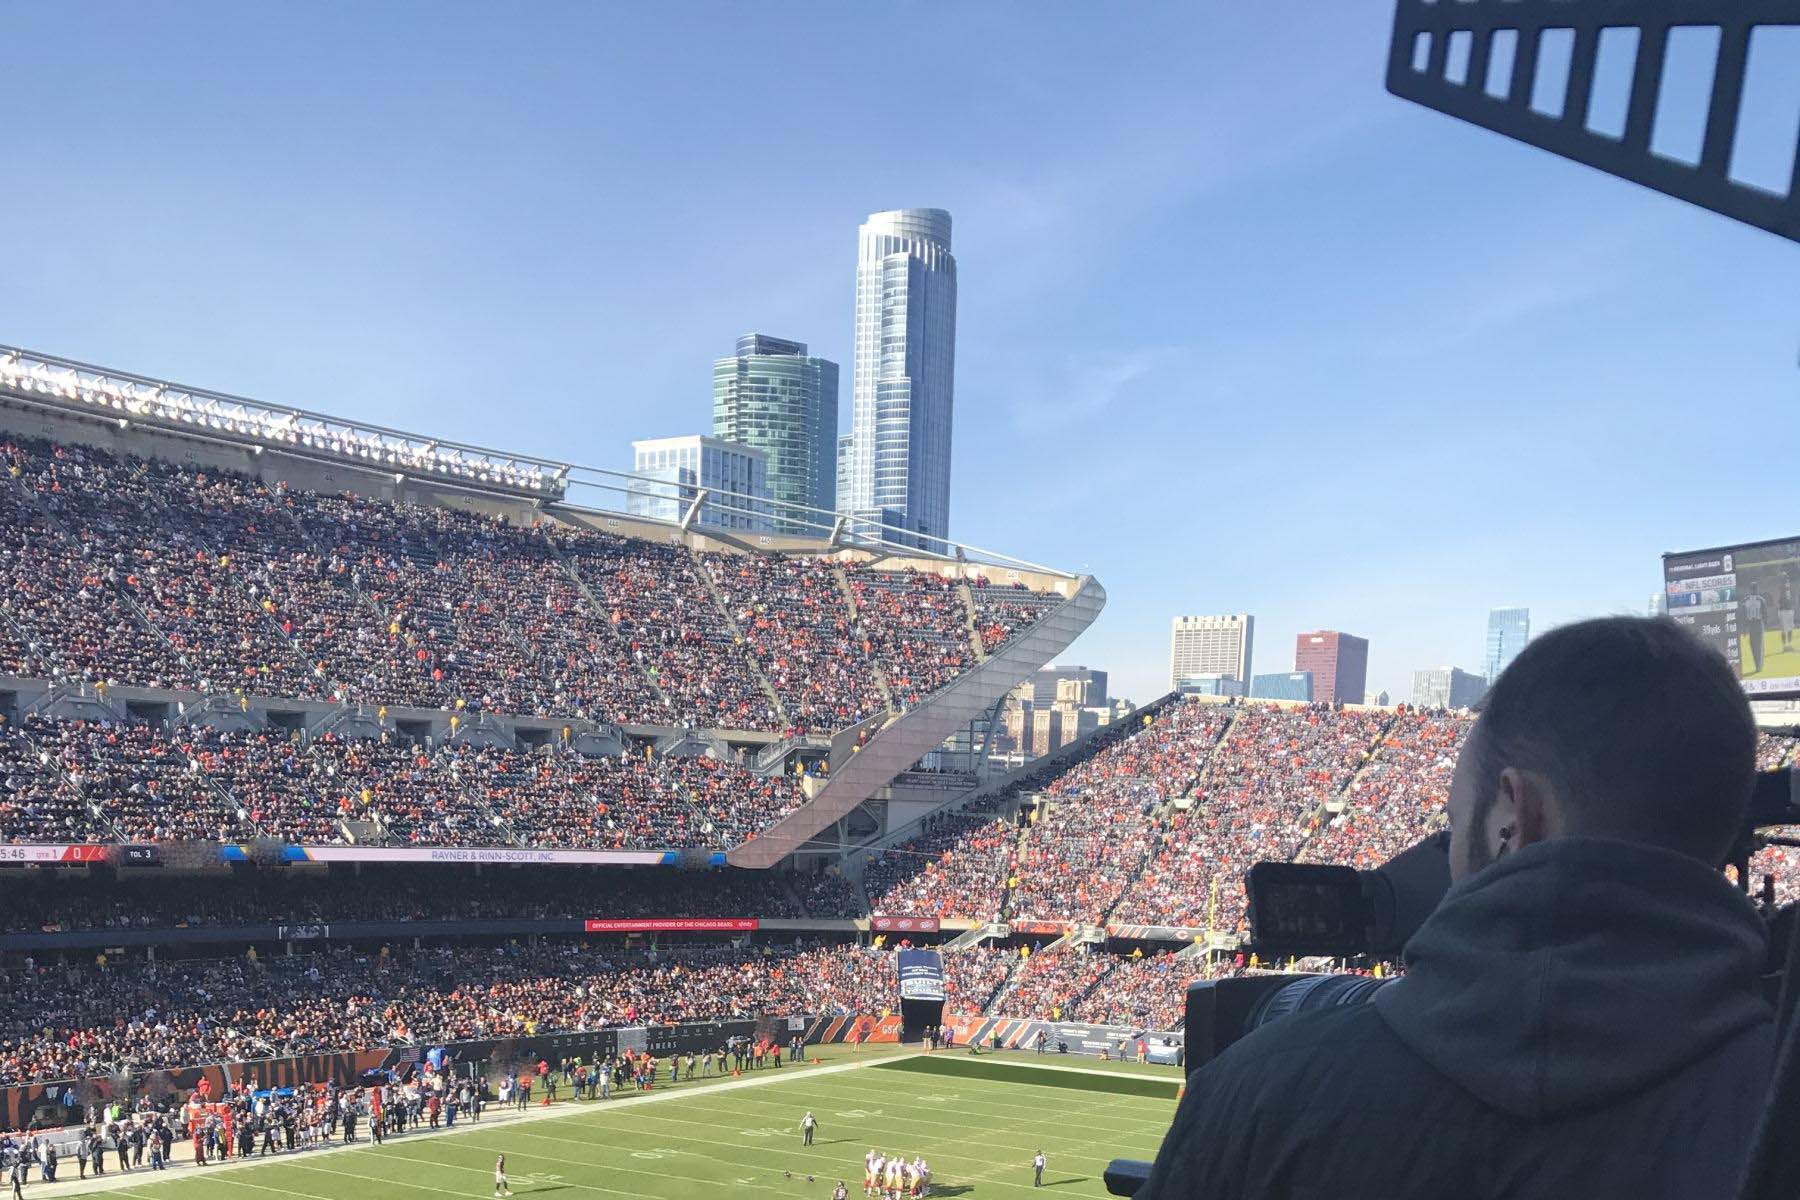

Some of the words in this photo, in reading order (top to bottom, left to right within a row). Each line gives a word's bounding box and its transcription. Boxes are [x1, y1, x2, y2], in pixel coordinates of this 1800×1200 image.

[145, 850, 151, 858] 3
[432, 850, 468, 860] RAYNER
[470, 851, 476, 860] &
